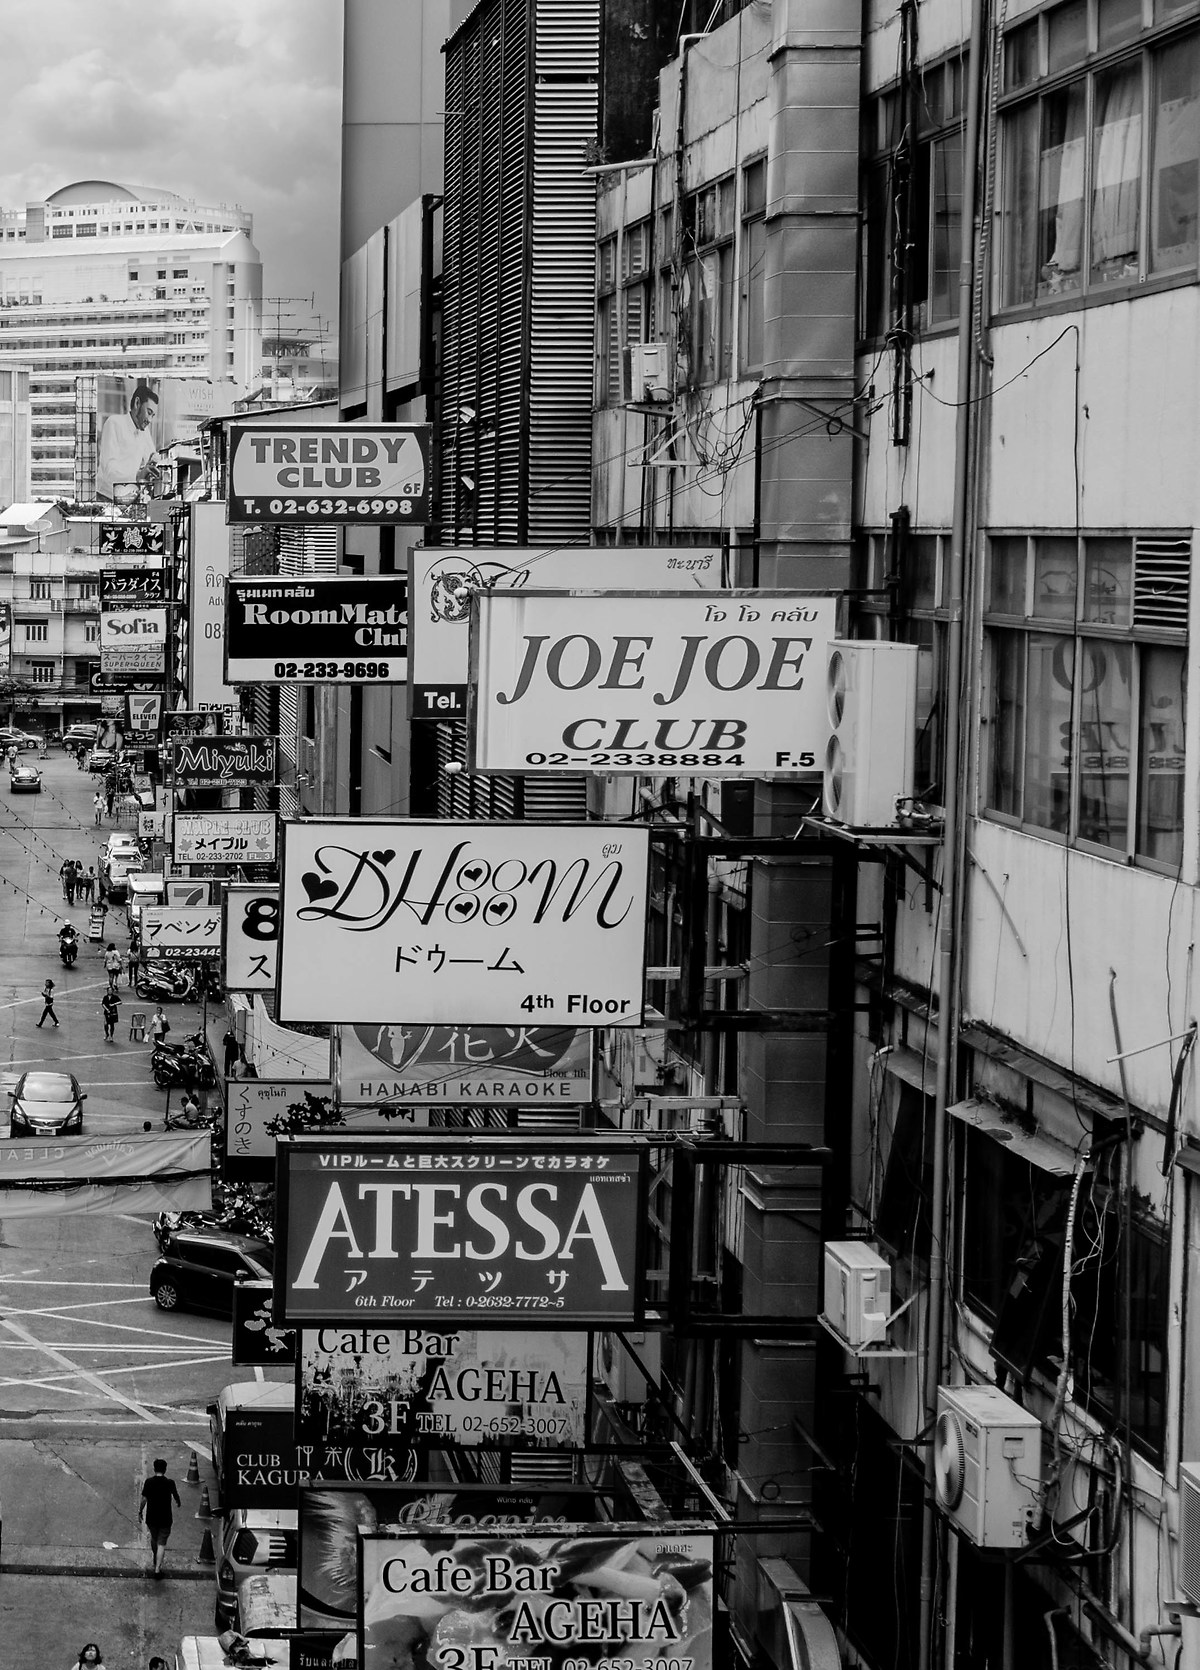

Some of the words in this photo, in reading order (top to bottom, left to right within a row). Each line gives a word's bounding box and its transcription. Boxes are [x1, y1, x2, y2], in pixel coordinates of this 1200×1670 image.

[251, 438, 407, 464] TRENDY
[277, 467, 382, 488] CLUB
[403, 483, 421, 495] 6F
[244, 500, 261, 514] T.
[269, 500, 413, 515] 02-632-6998
[103, 578, 161, 592] パラダイス
[107, 618, 159, 635] Sofia
[205, 622, 225, 639] 08
[274, 662, 390, 678] 02-233-9696
[496, 634, 653, 705] JOE
[653, 635, 813, 706] JOE
[423, 691, 462, 709] Tel.
[561, 718, 748, 751] CLUB
[175, 744, 273, 779] Miyuki
[524, 751, 746, 767] 02-2338884
[774, 751, 816, 767] F.5
[195, 836, 249, 851] メイプル
[519, 994, 556, 1013] 4th
[567, 994, 632, 1014] Floor
[360, 1083, 448, 1096] HANABI
[459, 1082, 572, 1096] KARAOKE
[234, 1086, 253, 1155] くすのき
[291, 1181, 630, 1292] ATESSA
[354, 1295, 377, 1308] 6th
[380, 1295, 416, 1308] Floor
[434, 1295, 455, 1308] Tel
[317, 1329, 391, 1357] Cafe
[401, 1329, 461, 1358] Bar
[427, 1367, 568, 1405] AGEHA
[361, 1400, 411, 1435] 3F
[416, 1412, 458, 1434] TEL
[462, 1413, 568, 1436] 02-652-3007
[236, 1453, 282, 1467] CLUB
[381, 1557, 473, 1594] Cafe
[485, 1557, 559, 1593] Bar
[509, 1600, 679, 1642] AGEHA
